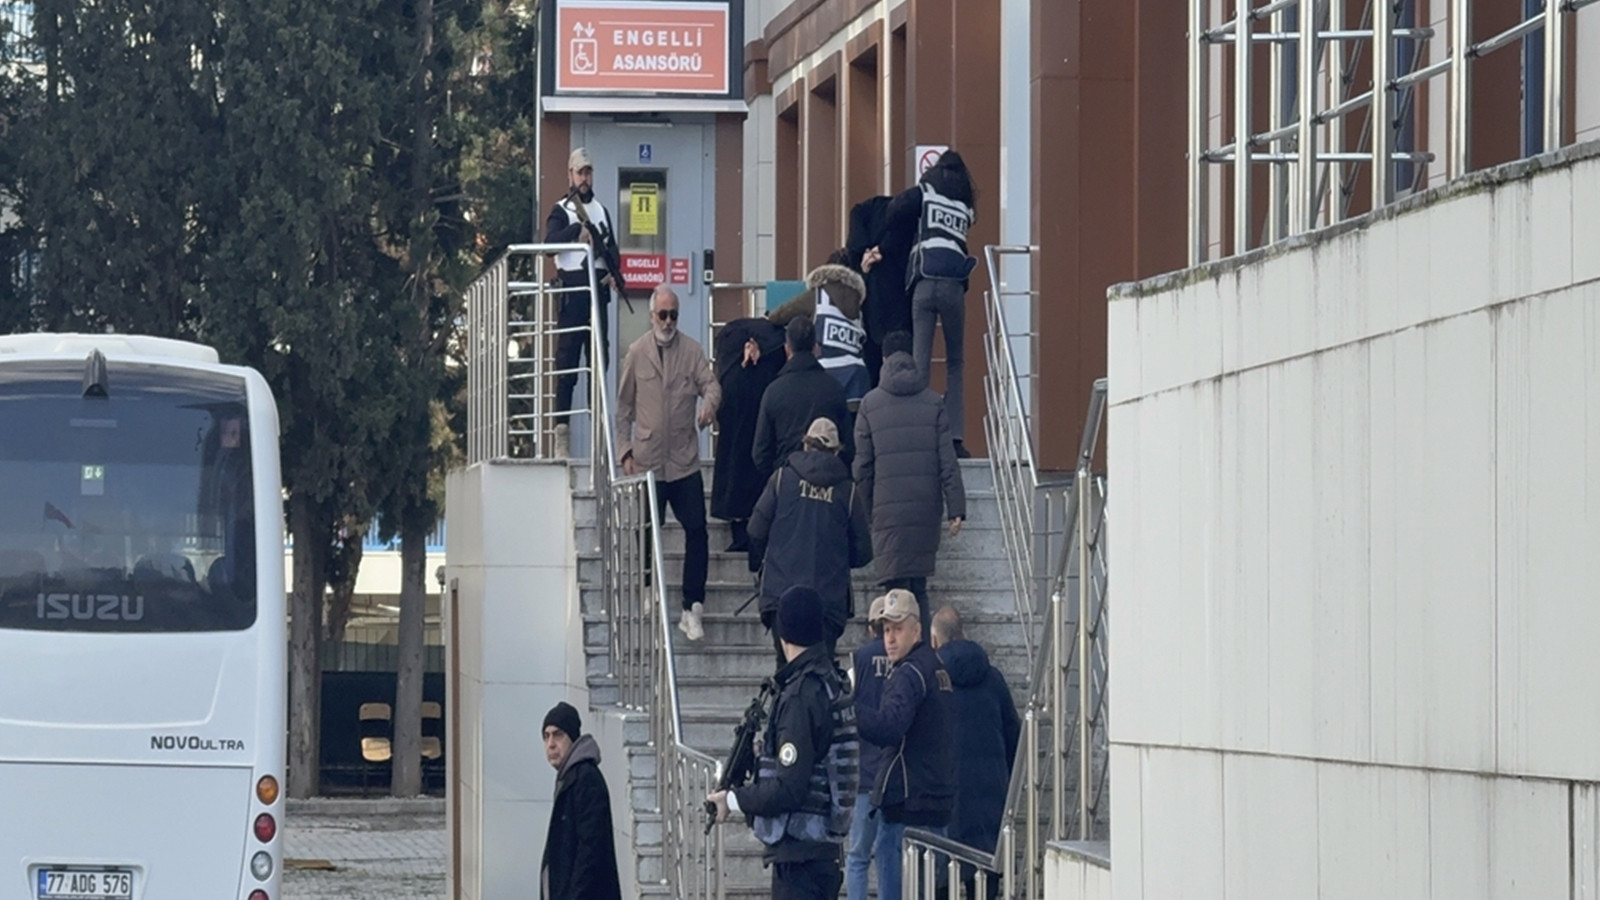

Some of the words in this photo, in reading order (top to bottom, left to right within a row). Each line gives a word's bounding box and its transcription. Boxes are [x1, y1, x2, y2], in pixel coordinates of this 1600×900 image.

[613, 28, 702, 46] ENGELLİ
[612, 53, 702, 71] ASANSÖRÜ
[799, 479, 834, 503] TEM
[37, 593, 144, 620] ISUZU
[48, 874, 65, 892] 77
[103, 874, 129, 893] 576
